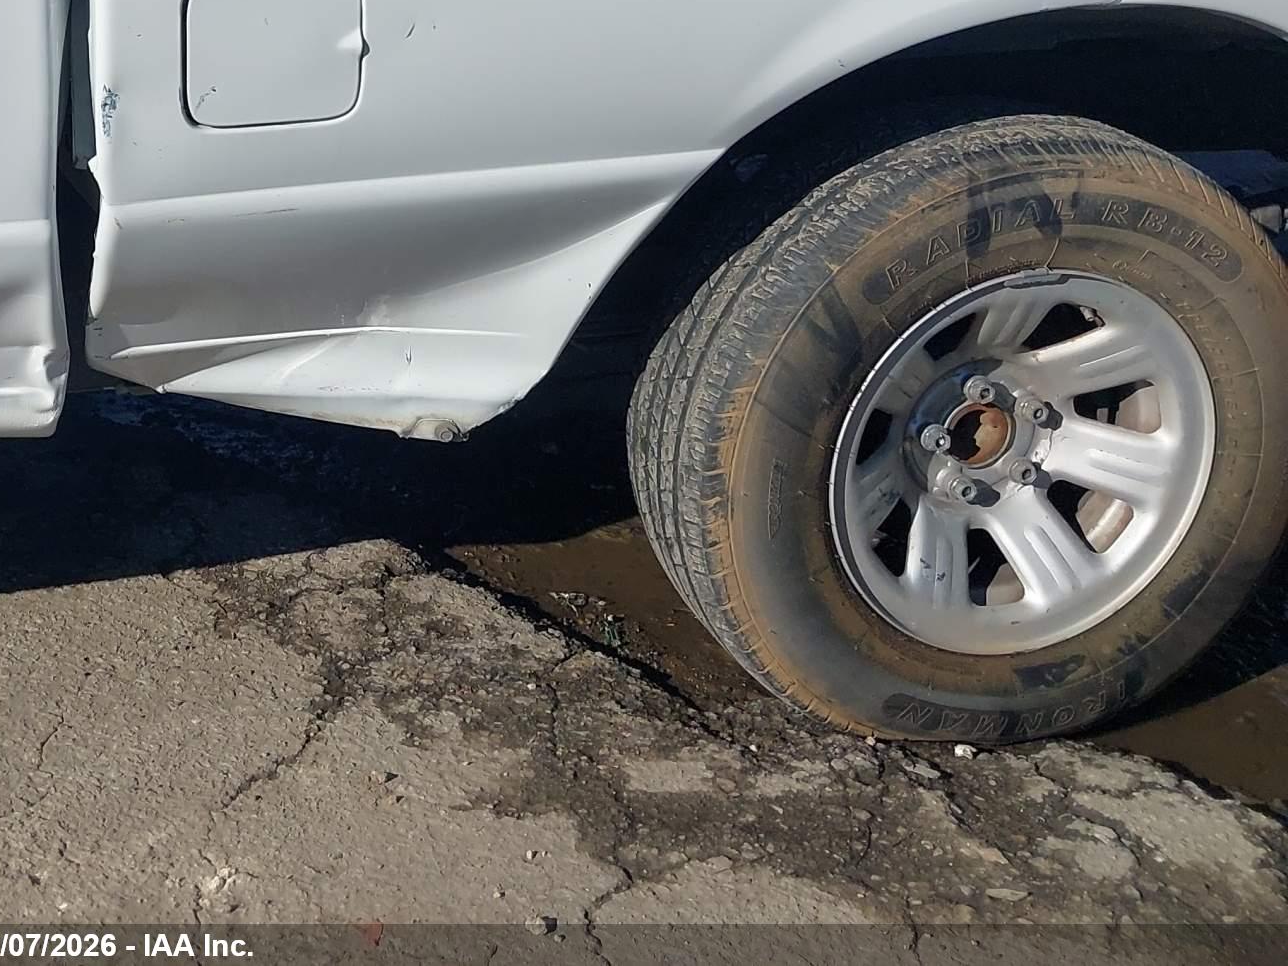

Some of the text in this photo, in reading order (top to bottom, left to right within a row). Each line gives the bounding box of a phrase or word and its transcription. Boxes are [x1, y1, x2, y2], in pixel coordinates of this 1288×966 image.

[884, 198, 1232, 291] RADIAL RB-12
[896, 680, 1128, 740] IRONMAN
